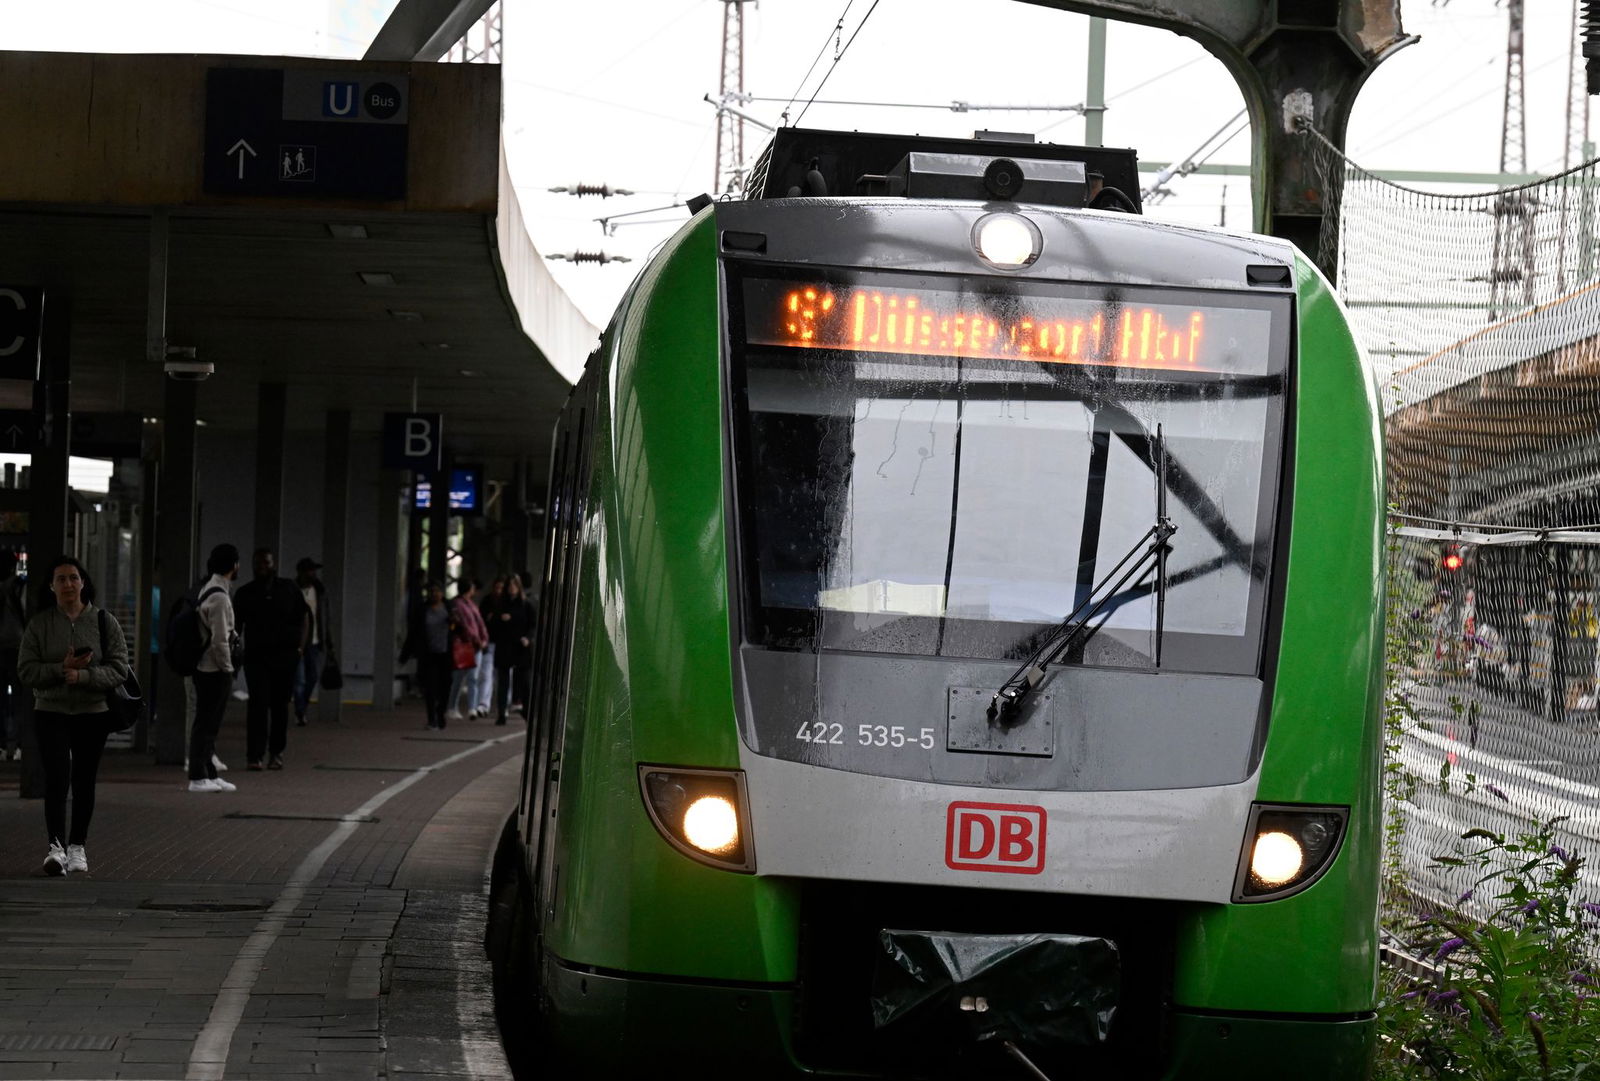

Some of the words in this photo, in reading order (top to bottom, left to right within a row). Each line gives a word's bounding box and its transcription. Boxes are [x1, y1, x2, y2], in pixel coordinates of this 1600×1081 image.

[329, 84, 353, 115] U
[371, 94, 394, 107] Bus
[404, 417, 432, 457] B
[796, 721, 844, 744] 422
[858, 724, 935, 749] 535-5
[958, 812, 1034, 862] DB
